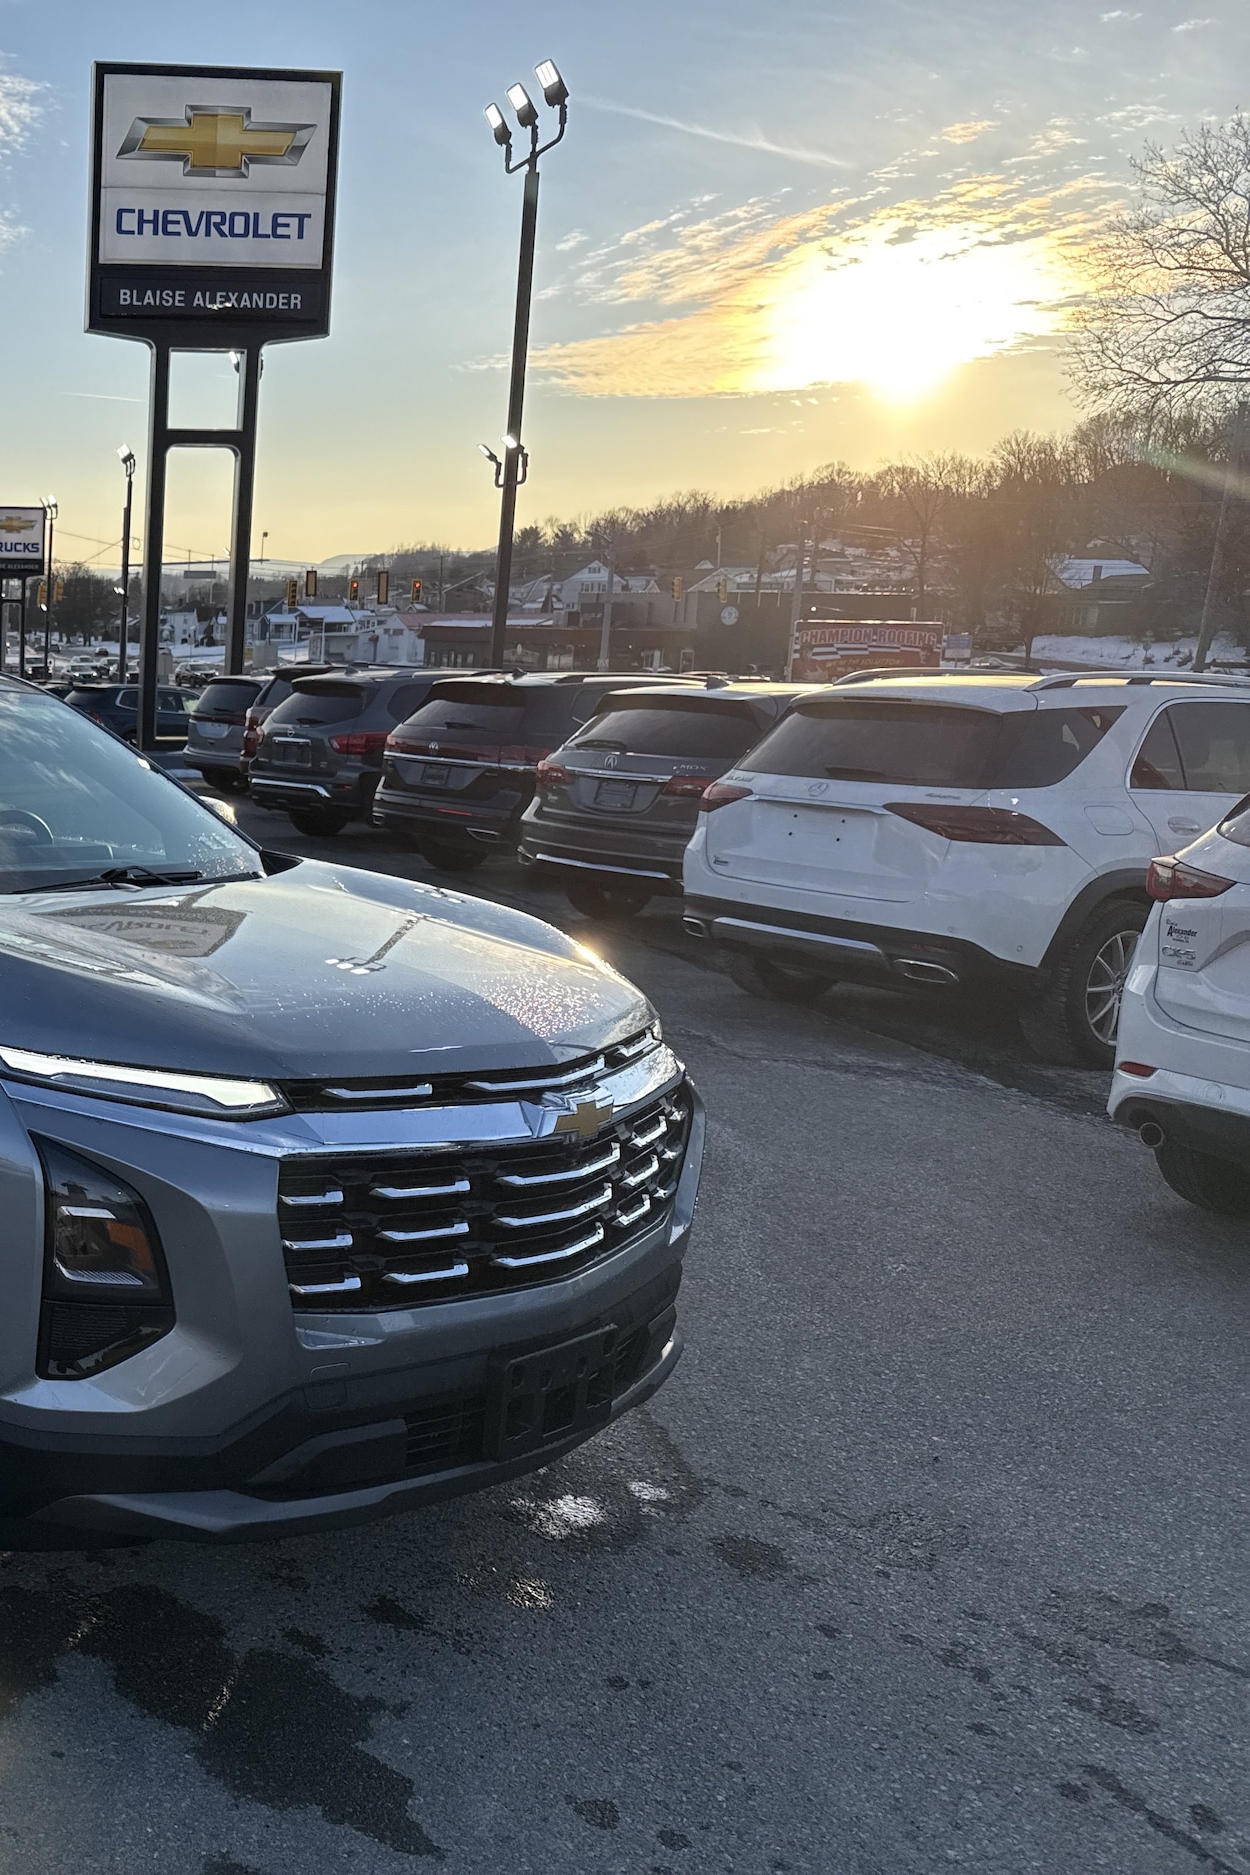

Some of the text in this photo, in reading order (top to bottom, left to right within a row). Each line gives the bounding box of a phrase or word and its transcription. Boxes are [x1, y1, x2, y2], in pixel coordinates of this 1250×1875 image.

[116, 208, 312, 240] CHEVROLET
[119, 289, 302, 310] BLAISE ALEXANDER
[801, 627, 873, 645] CHAMPION
[877, 628, 938, 647] ROOFING
[1166, 925, 1198, 938] Alexander
[1161, 945, 1197, 960] CX-5
